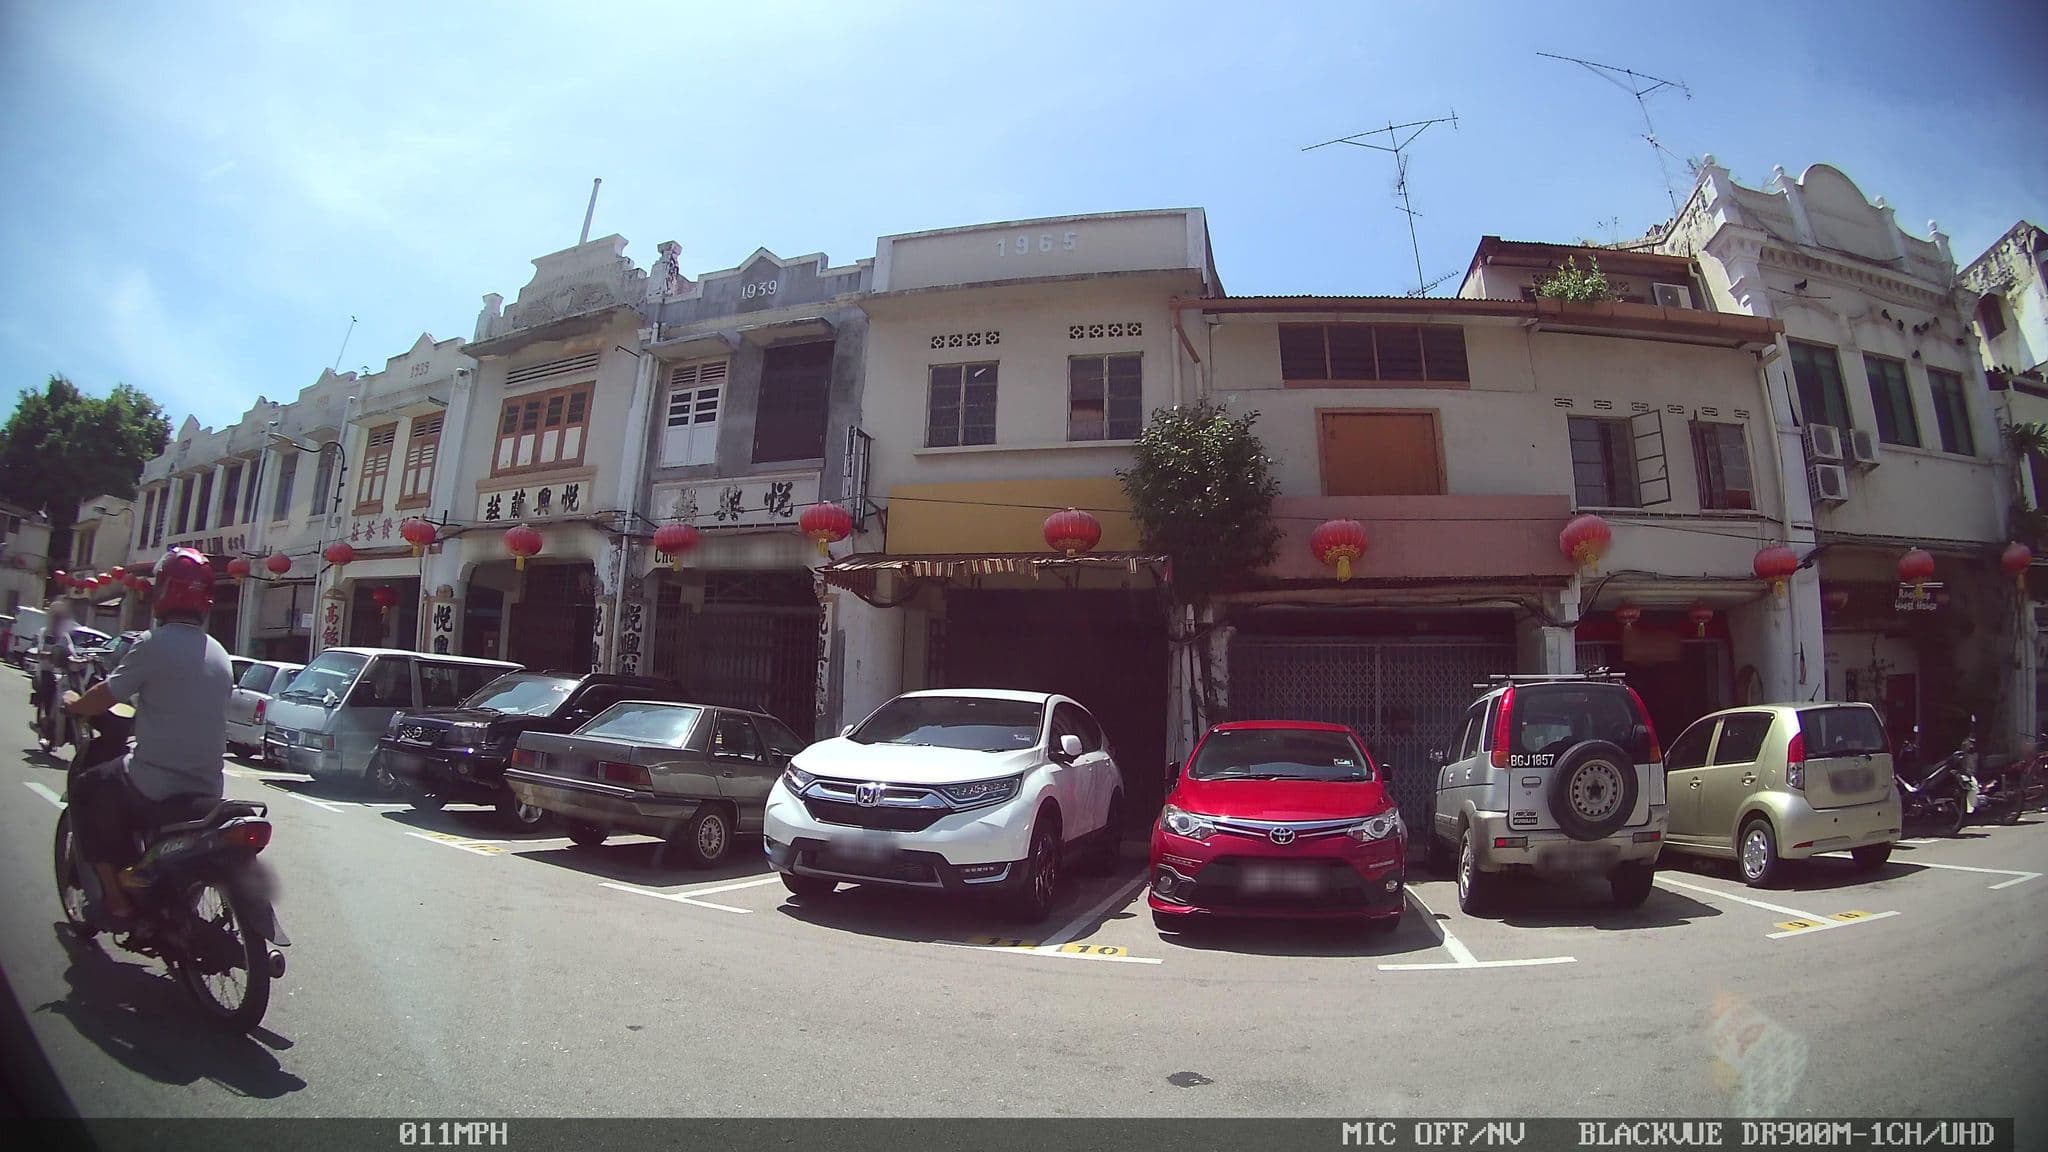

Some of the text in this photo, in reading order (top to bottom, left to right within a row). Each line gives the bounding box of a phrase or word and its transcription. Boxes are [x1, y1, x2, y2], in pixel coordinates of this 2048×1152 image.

[995, 231, 1079, 257] 1965
[741, 279, 777, 300] 1939
[1510, 753, 1555, 767] BGJ1857
[1077, 945, 1120, 955] 10
